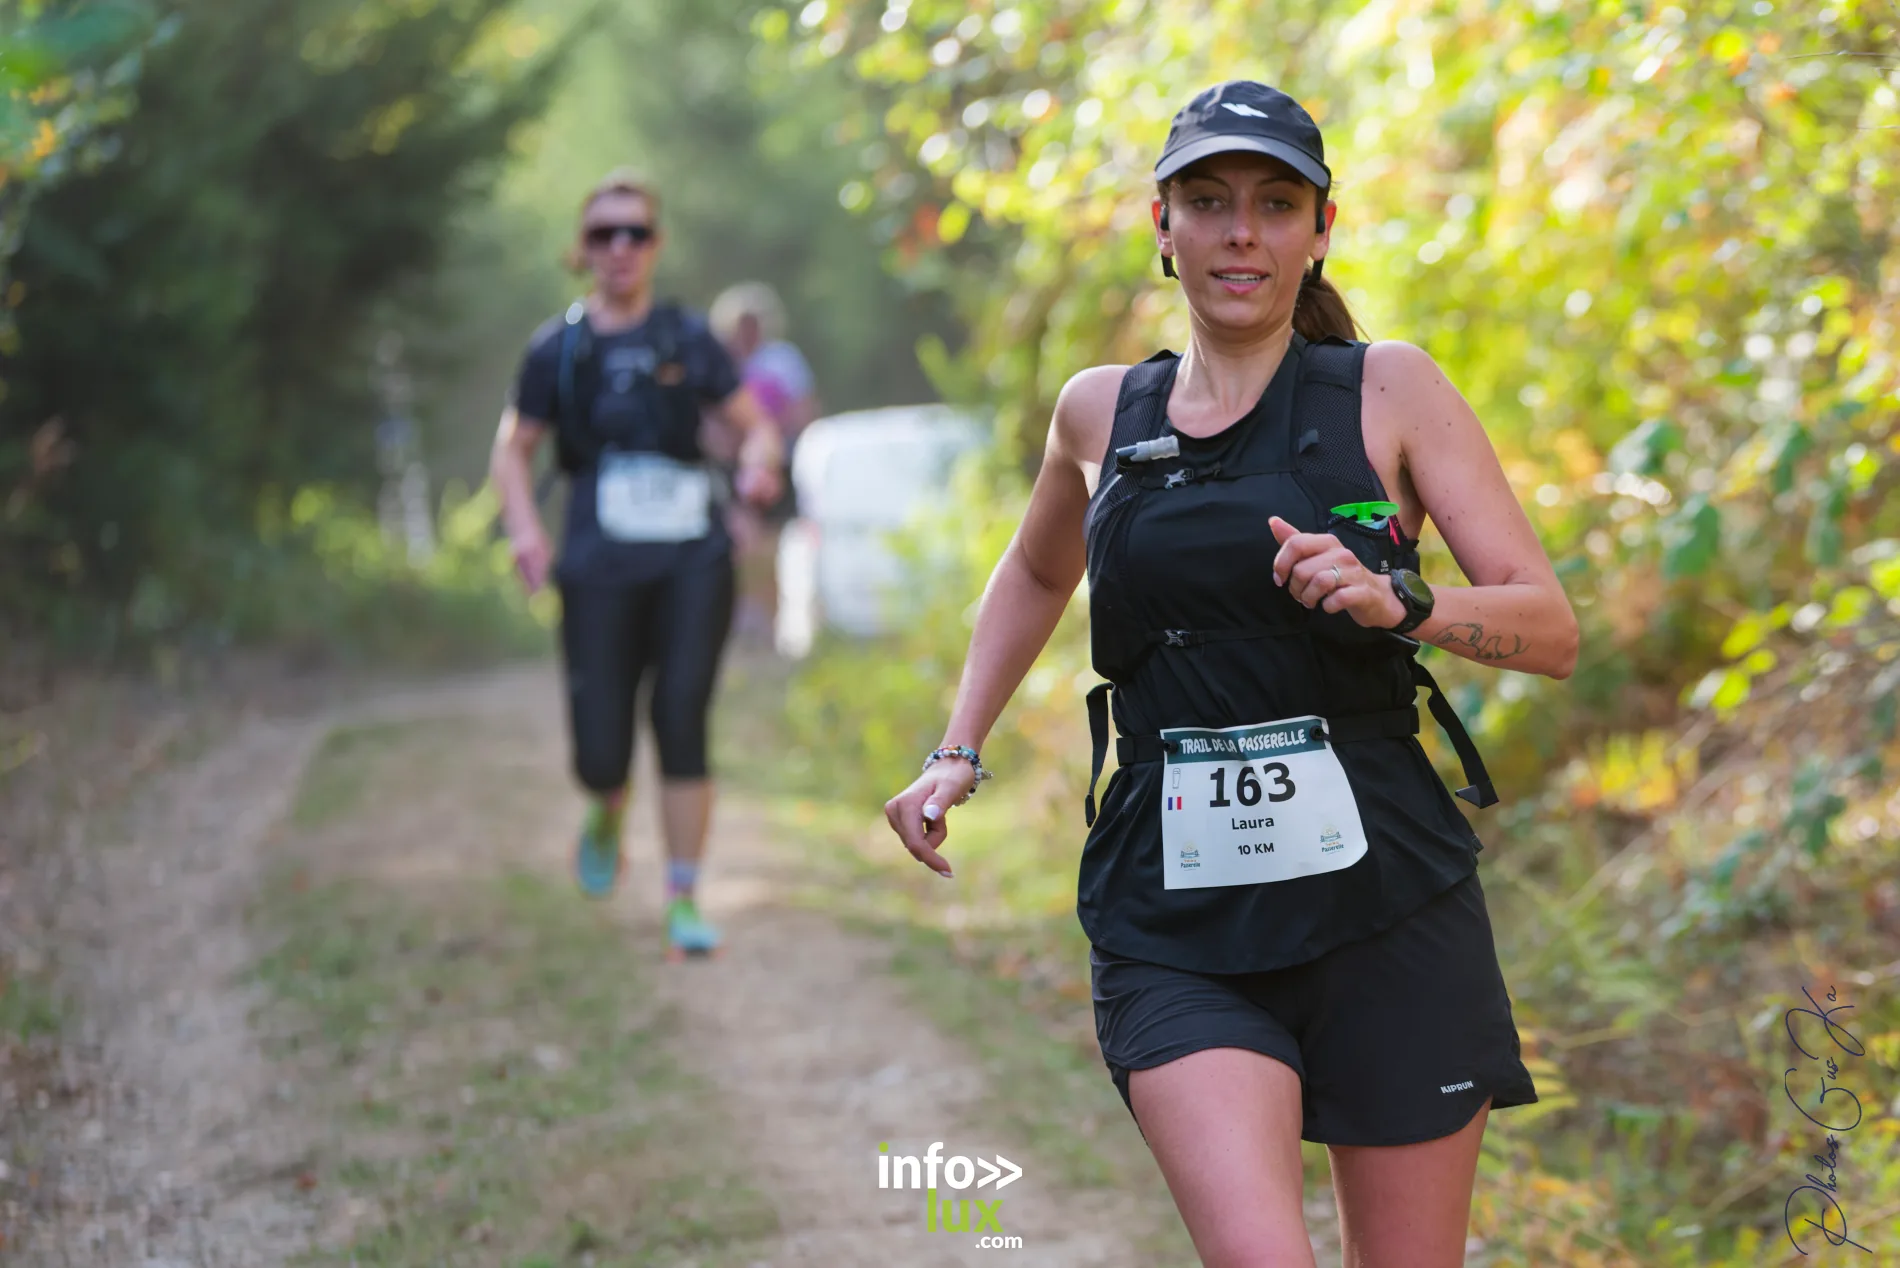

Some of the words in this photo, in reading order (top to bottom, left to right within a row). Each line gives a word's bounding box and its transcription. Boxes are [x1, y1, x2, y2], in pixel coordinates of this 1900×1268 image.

[1180, 738, 1212, 754] TRAIL
[1212, 738, 1225, 752] DE
[1223, 739, 1238, 753] LA
[1238, 728, 1307, 753] PASSERELLE
[1209, 762, 1296, 808] 163
[1231, 817, 1275, 830] Laura
[1237, 844, 1251, 855] 10
[1254, 842, 1275, 854] KM
[1440, 1080, 1474, 1094] KIPRUN
